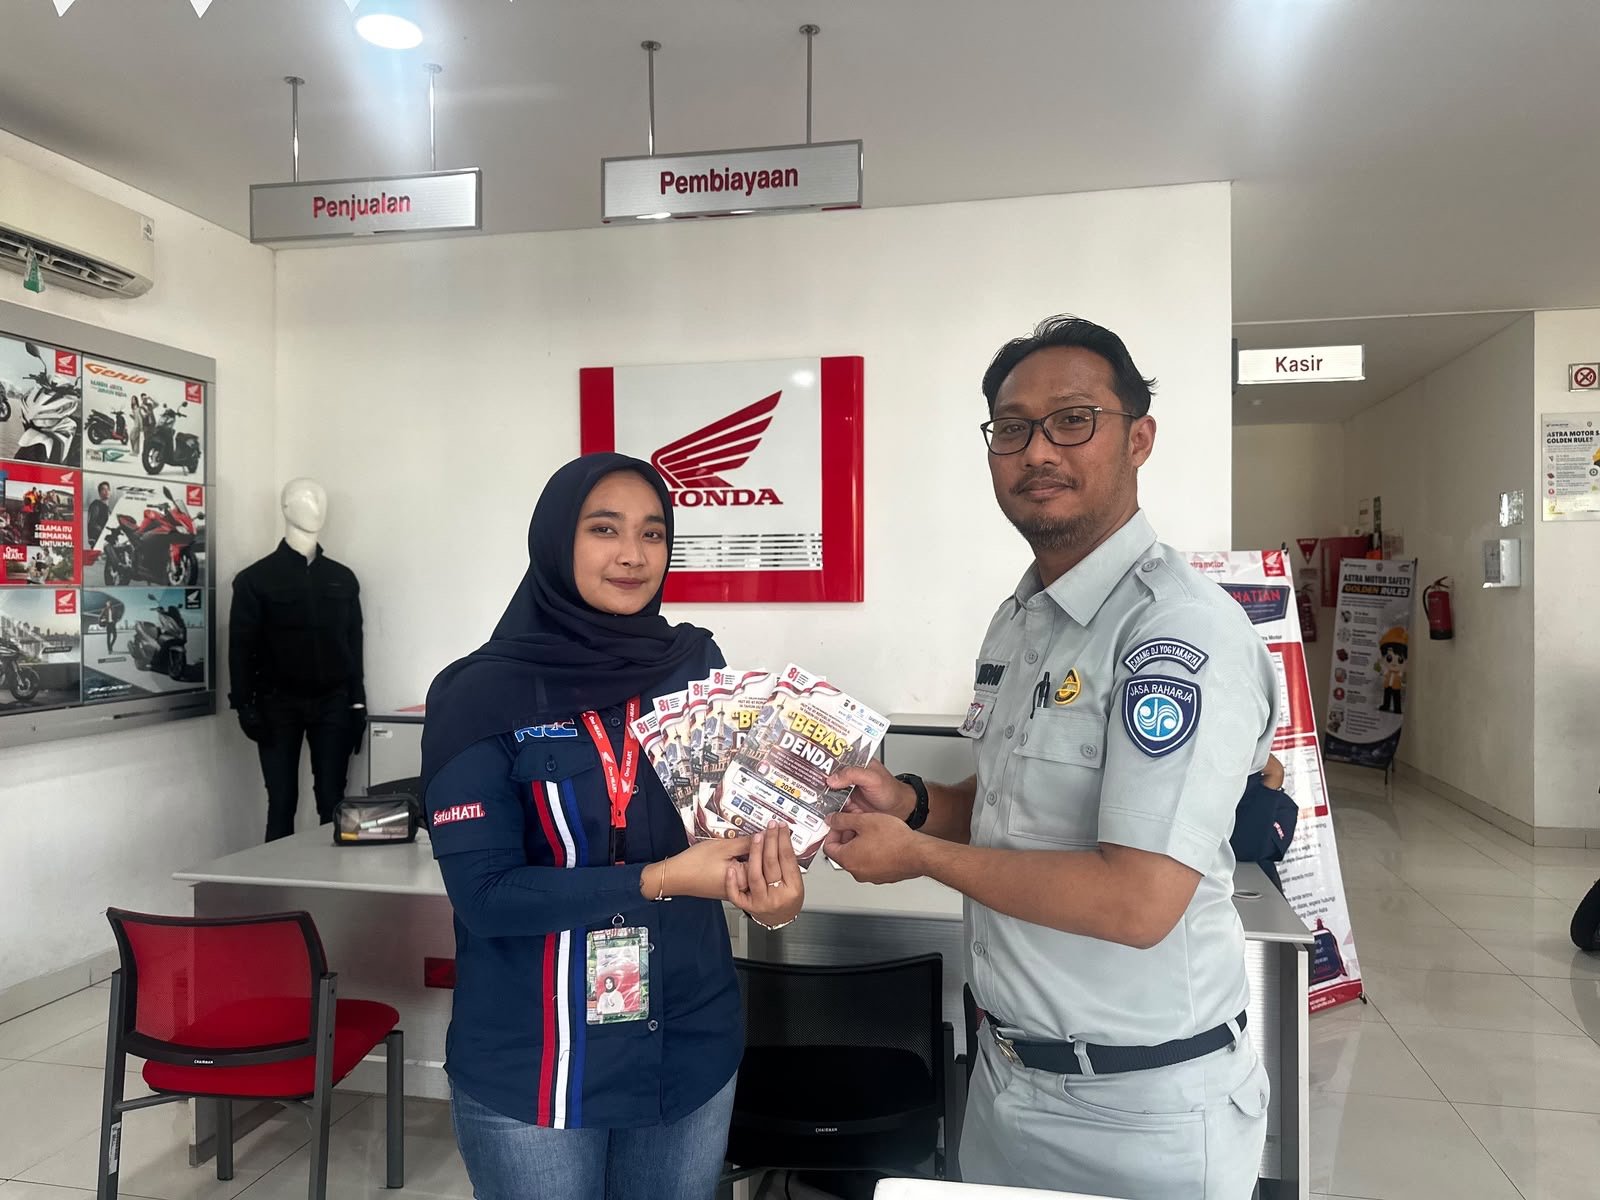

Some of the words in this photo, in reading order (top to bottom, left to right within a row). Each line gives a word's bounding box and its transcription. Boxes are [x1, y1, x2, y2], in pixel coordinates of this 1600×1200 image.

[660, 168, 799, 196] Pembiayaan
[313, 192, 411, 221] Penjualan
[1275, 355, 1323, 373] Kasir
[85, 363, 150, 385] Genio
[34, 532, 72, 540] BERMAKNA
[35, 524, 61, 532] SELAMA
[1344, 574, 1363, 582] ASTRA
[1365, 575, 1387, 584] MOTOR
[1388, 576, 1411, 585] SAFETY
[1380, 587, 1408, 597] RULES
[1159, 645, 1199, 666] YOGYAKARTA
[787, 667, 799, 682] 81
[1130, 684, 1150, 697] JASA
[1151, 684, 1193, 703] RAHARJA
[780, 734, 834, 775] DENDA
[780, 782, 796, 794] 2026
